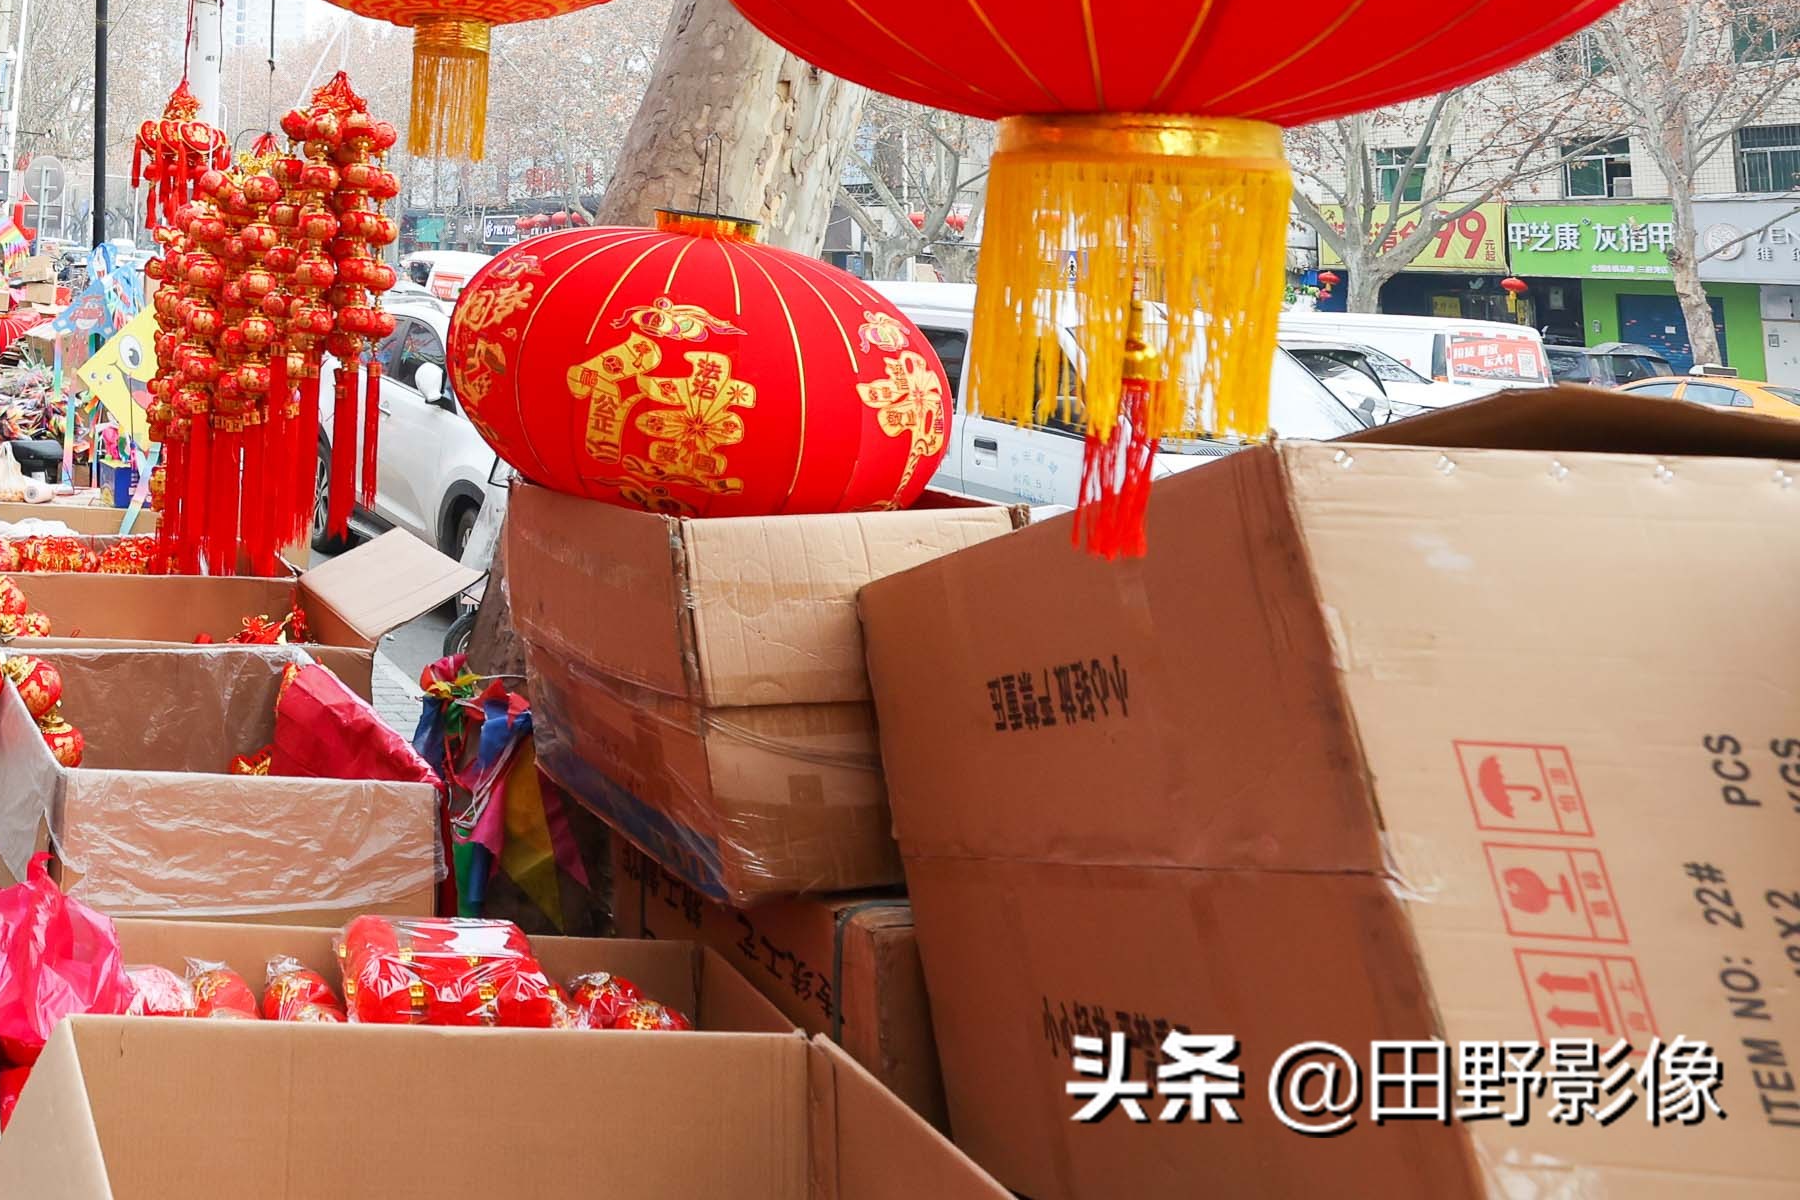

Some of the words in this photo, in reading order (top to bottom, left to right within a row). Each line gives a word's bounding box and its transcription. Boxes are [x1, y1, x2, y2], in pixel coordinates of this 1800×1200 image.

[1591, 220, 1674, 255] 灰指甲
[1703, 733, 1763, 808] PCS
[1683, 861, 1745, 930] 22#
[1741, 1036, 1800, 1129] ITEM
